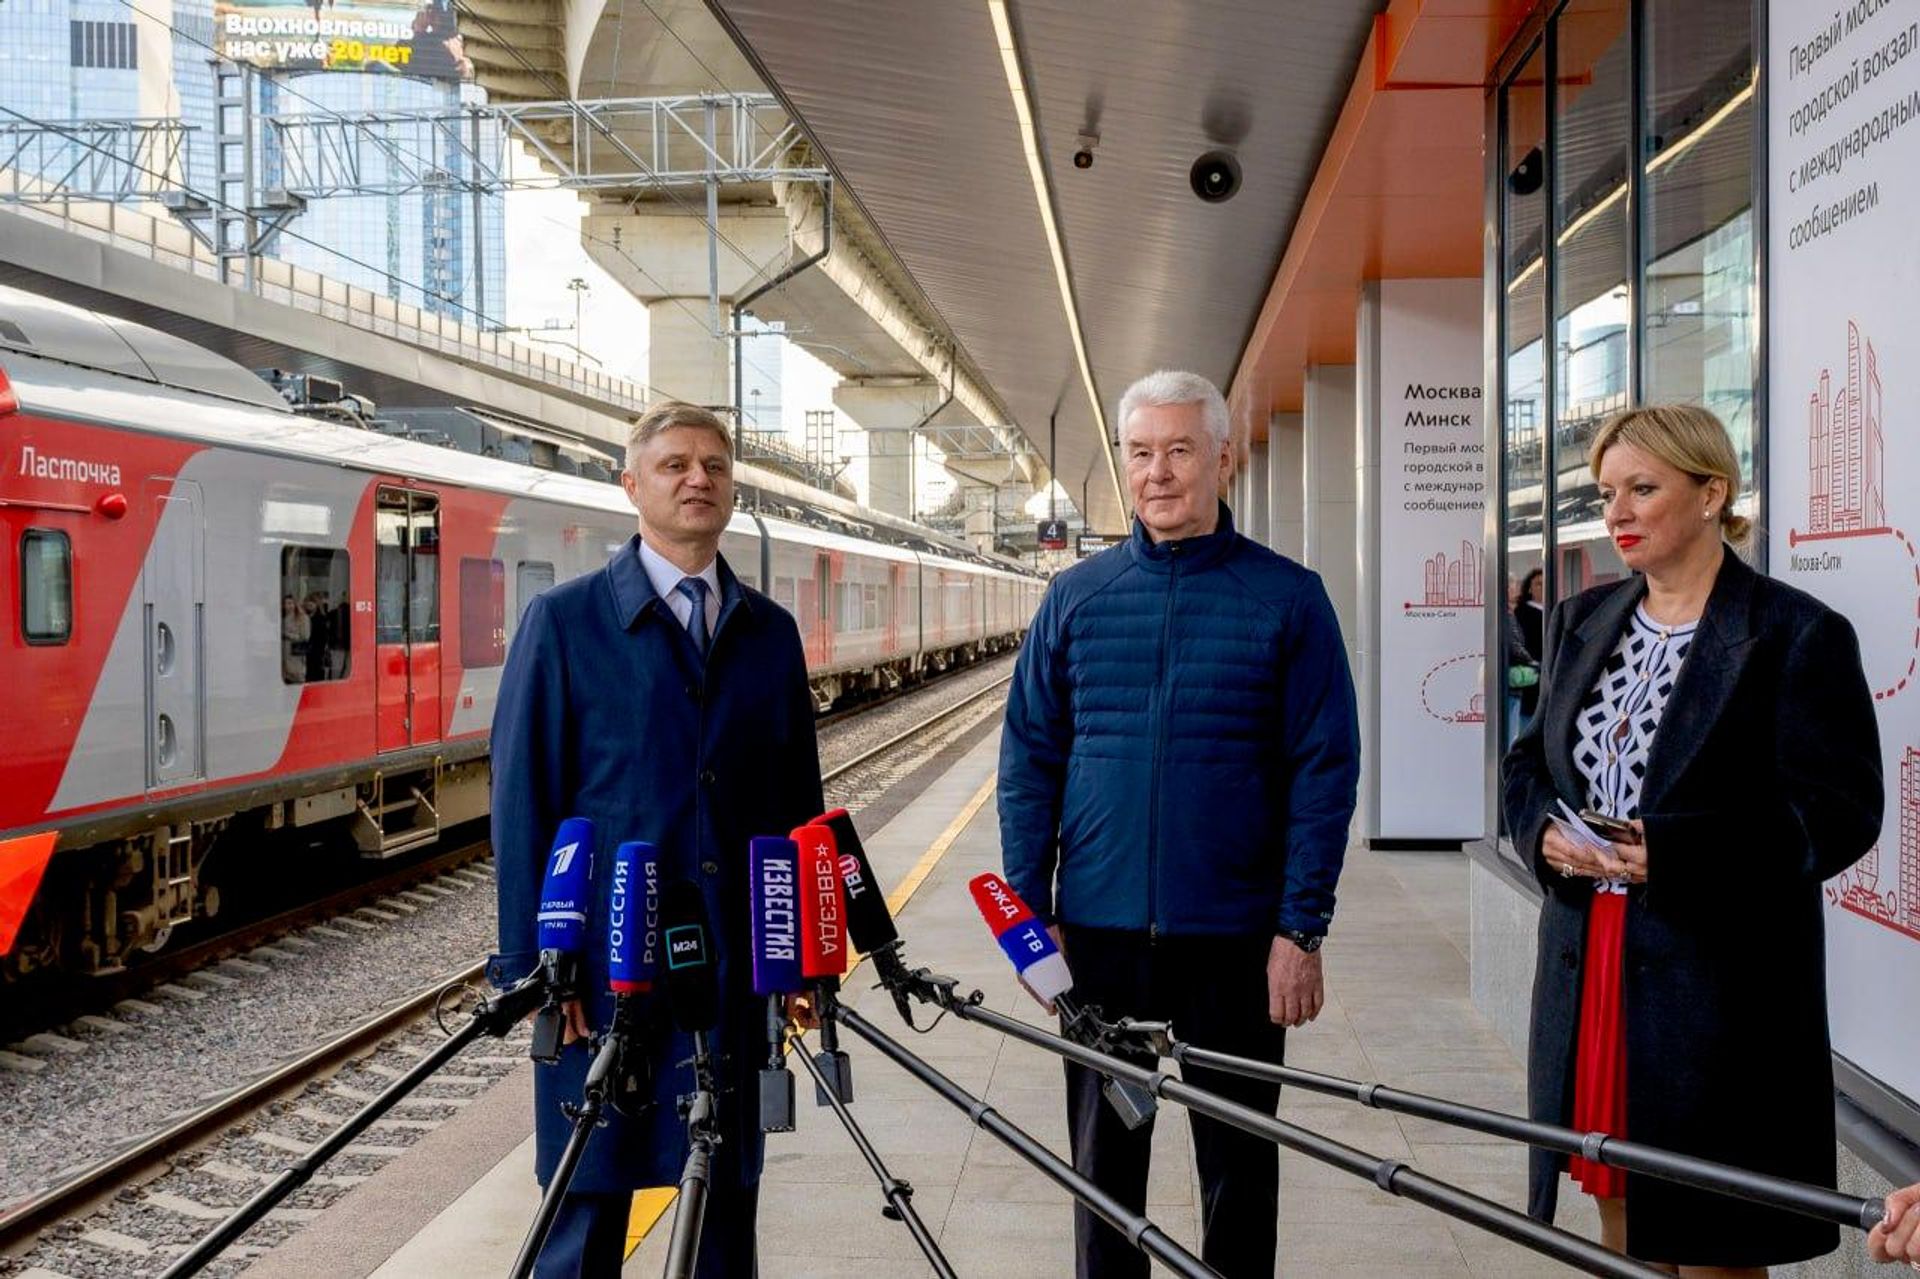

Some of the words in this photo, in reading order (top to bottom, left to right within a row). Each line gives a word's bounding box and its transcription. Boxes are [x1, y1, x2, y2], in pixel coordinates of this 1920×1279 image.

[225, 13, 414, 39] Вдохновляешь
[225, 41, 271, 58] нас
[273, 40, 327, 63] уже
[332, 39, 364, 61] 20
[369, 44, 413, 64] лет
[1789, 12, 1842, 80] Первый
[1845, 0, 1889, 36] мос
[1789, 58, 1859, 137] городской
[1863, 22, 1918, 84] вокзал
[1789, 170, 1796, 193] с
[1789, 182, 1879, 250] сообщением
[1404, 384, 1482, 400] Москва
[1404, 411, 1471, 427] Минск
[1404, 442, 1457, 455] Первый
[20, 446, 121, 486] Ласточка
[1404, 461, 1473, 474] городской
[1476, 463, 1484, 472] в
[1404, 482, 1411, 492] с
[1415, 482, 1484, 494] междунар
[1047, 524, 1058, 538] 4
[611, 861, 629, 963] РОССИЯ
[763, 858, 795, 960] ИЗВЕСТИЯ
[815, 860, 839, 956] ЗВЕЗДА
[983, 880, 1019, 919] РЖД
[644, 862, 658, 963] РОССИЯ
[672, 940, 698, 953] М24
[1022, 928, 1044, 953] ТВ
